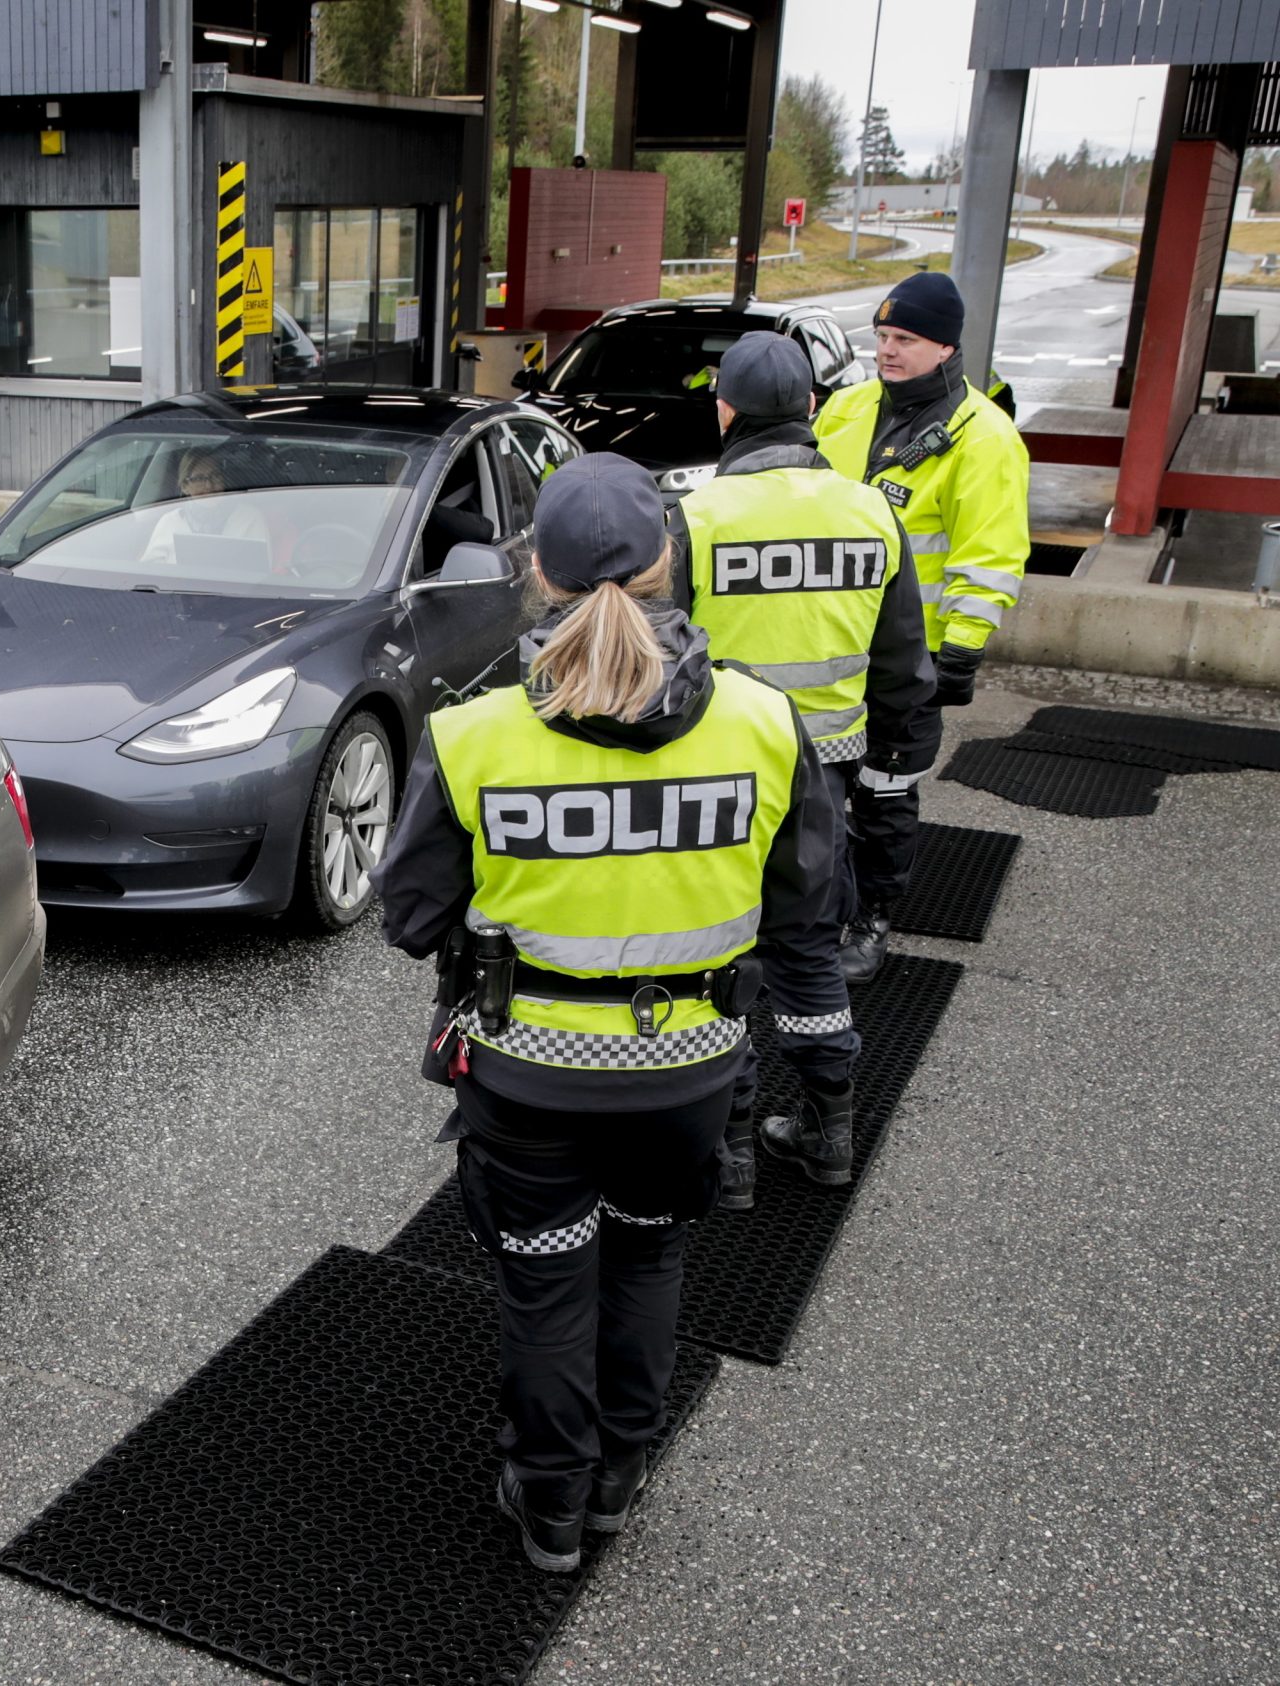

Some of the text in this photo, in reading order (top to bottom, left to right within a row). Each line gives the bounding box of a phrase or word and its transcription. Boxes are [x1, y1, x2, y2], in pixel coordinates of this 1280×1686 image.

[882, 480, 907, 499] TOLL
[715, 541, 885, 593] POLITI
[483, 778, 753, 854] POLITI
